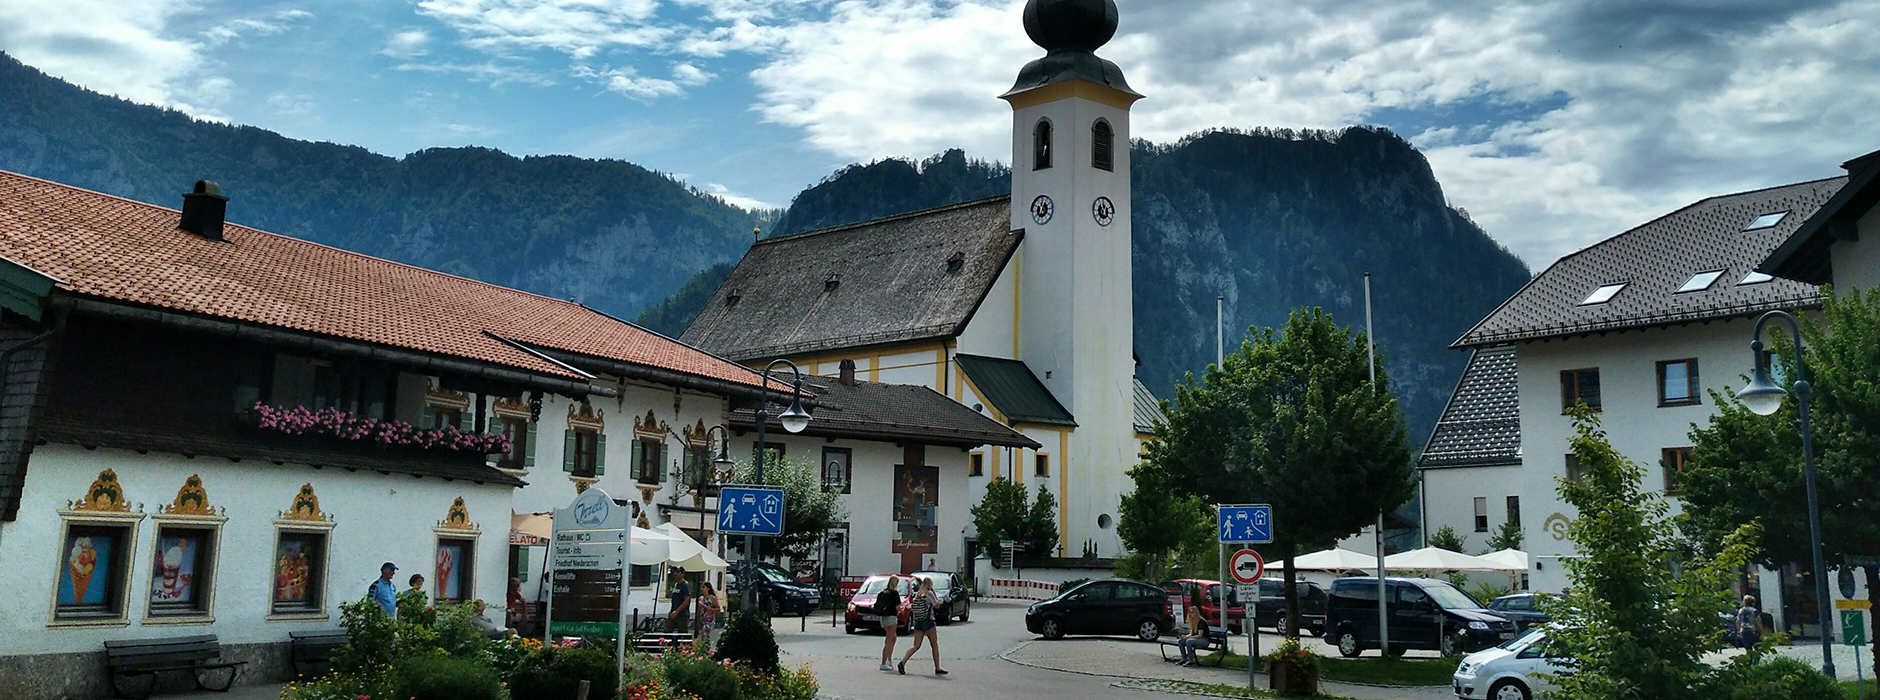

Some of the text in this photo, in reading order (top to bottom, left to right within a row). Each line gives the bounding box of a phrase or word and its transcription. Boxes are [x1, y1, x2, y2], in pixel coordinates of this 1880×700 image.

[557, 533, 573, 541] Rathaus
[577, 533, 584, 541] WC
[556, 546, 570, 554] Tourist
[573, 546, 582, 554] Info
[555, 559, 573, 567] Friedhof
